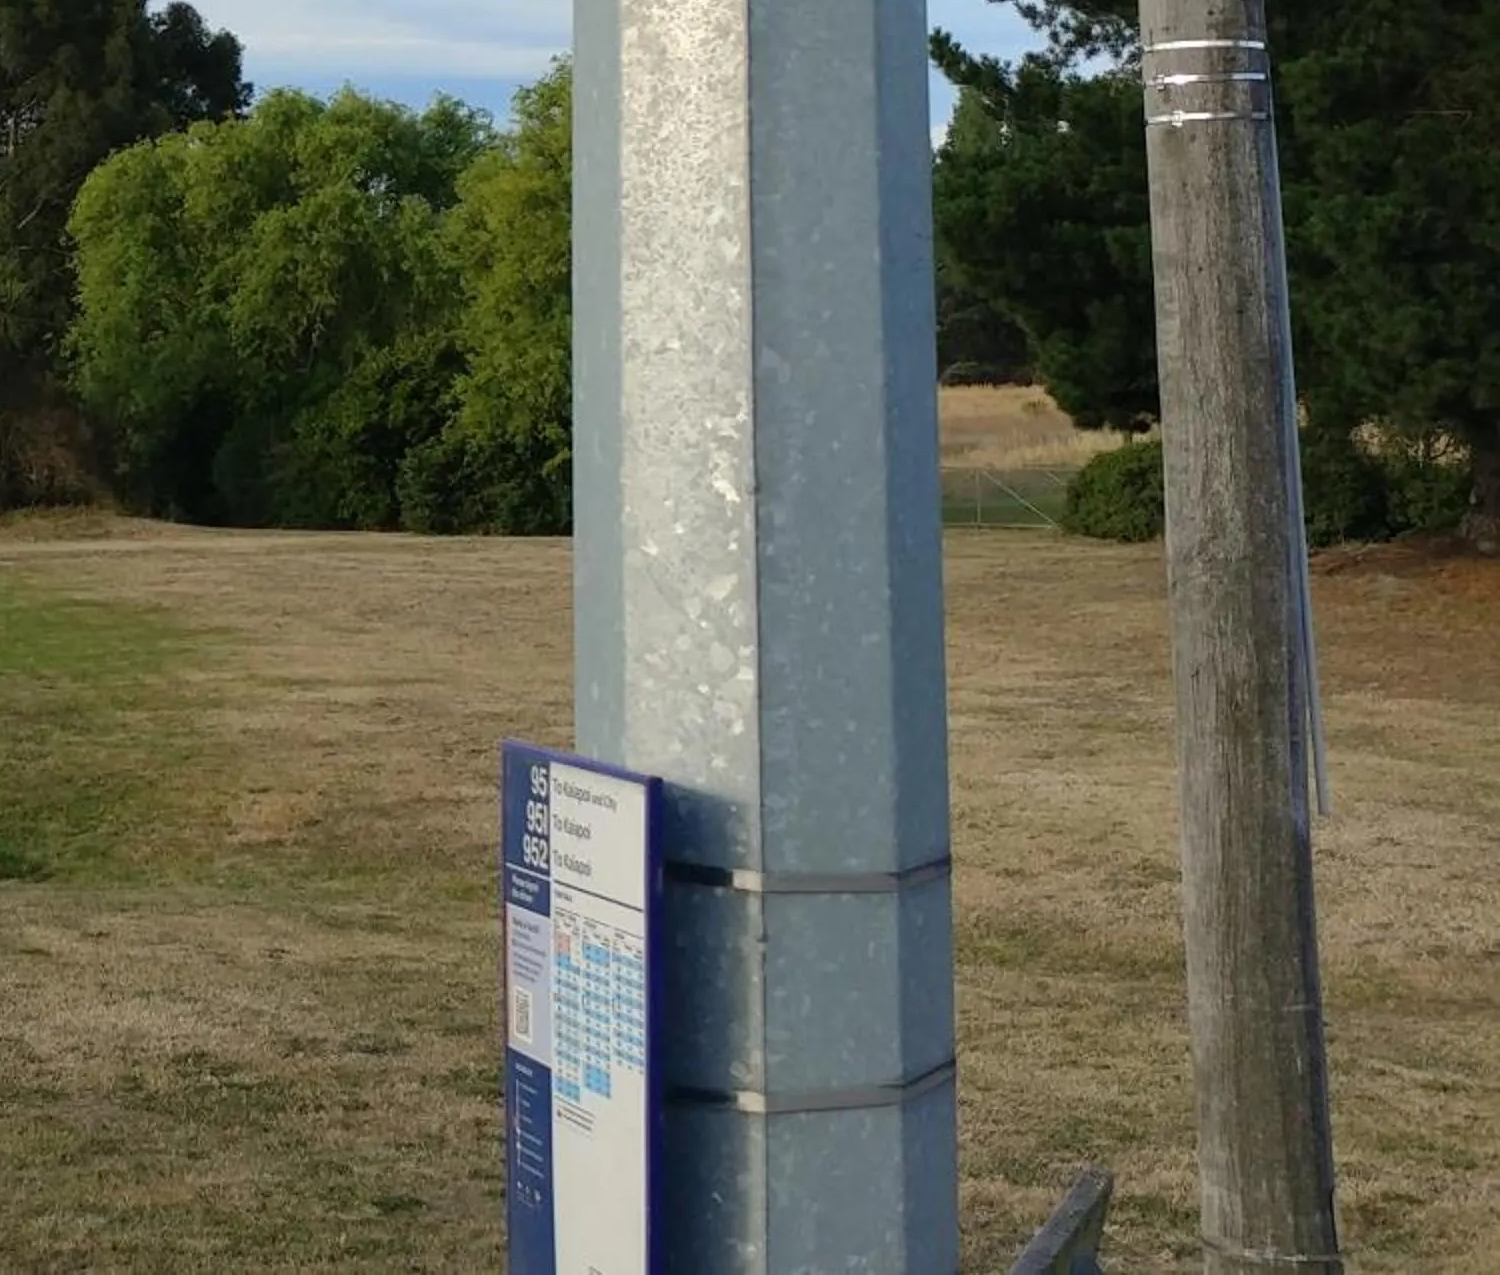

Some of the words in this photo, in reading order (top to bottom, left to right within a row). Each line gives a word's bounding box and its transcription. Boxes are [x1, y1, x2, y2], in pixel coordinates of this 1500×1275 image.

[530, 764, 548, 798] 95
[526, 800, 548, 836] 951
[522, 833, 549, 870] 952
